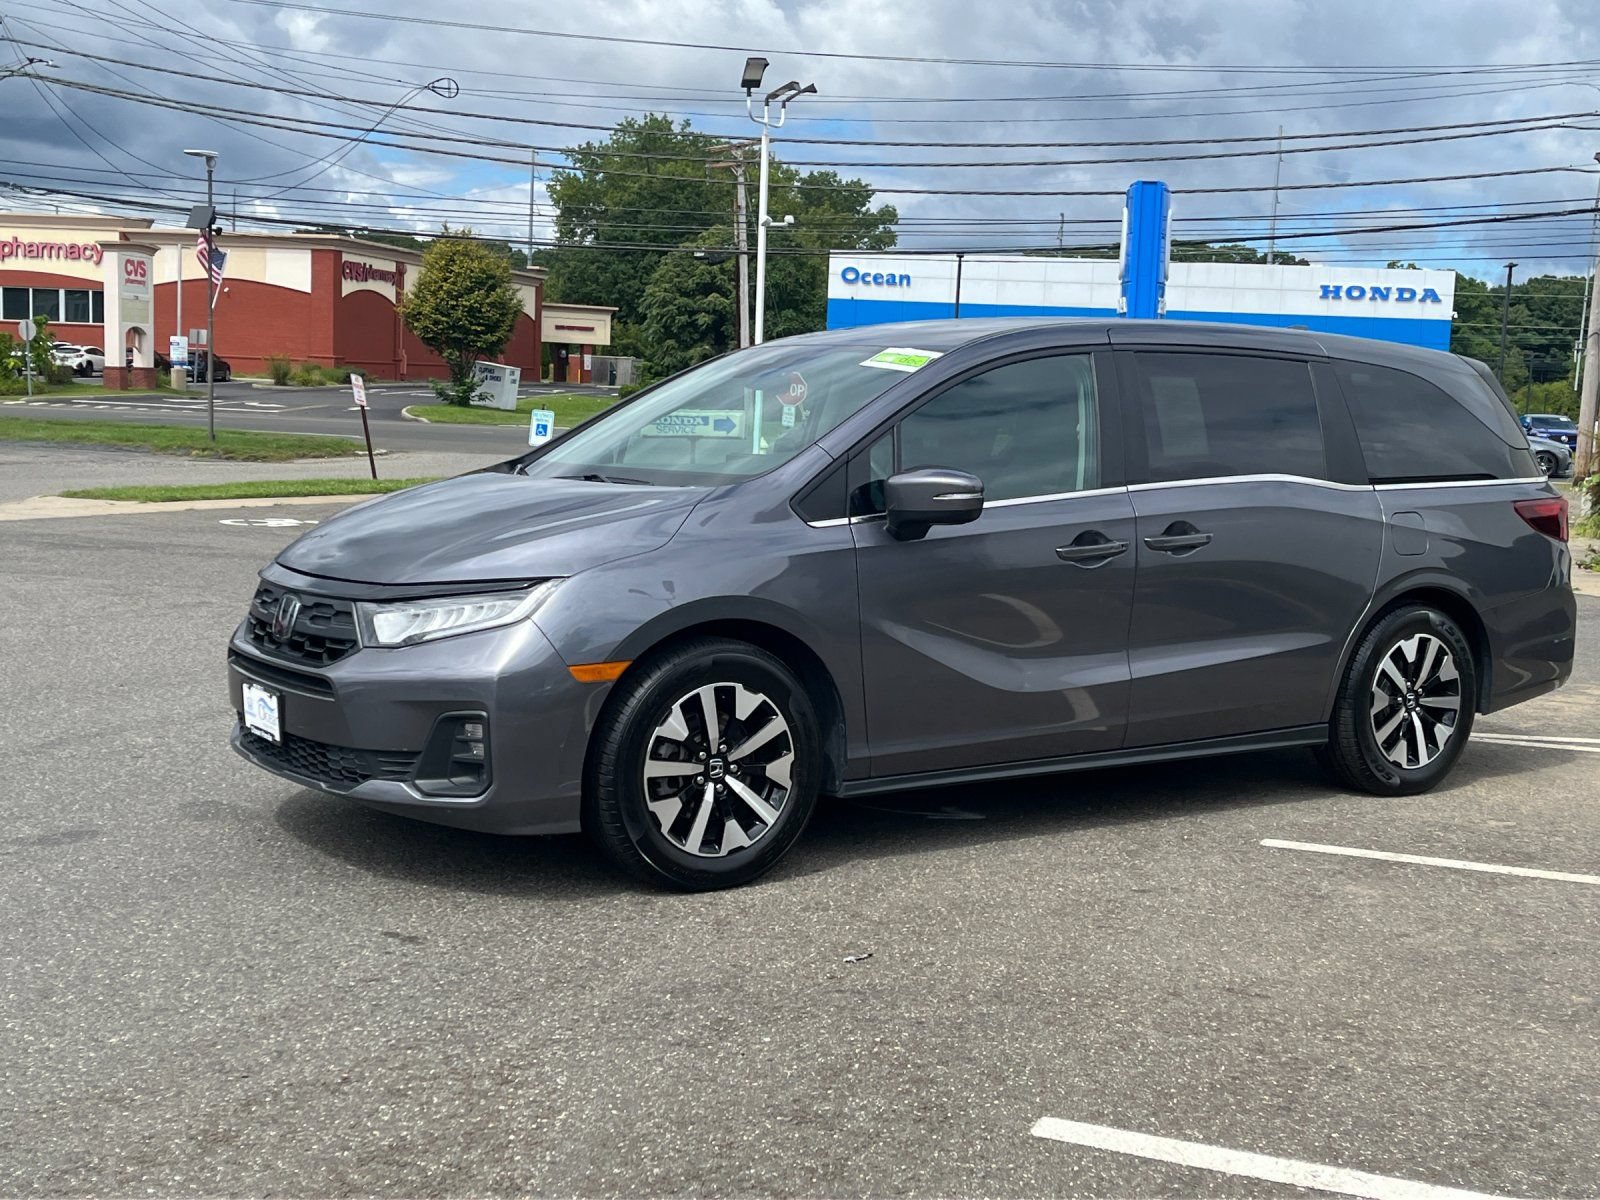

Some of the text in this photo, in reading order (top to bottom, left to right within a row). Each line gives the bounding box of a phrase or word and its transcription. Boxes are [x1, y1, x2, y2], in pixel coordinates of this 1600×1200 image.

[0, 236, 104, 265] pharmacy
[124, 258, 147, 278] CVS
[841, 266, 911, 287] Ocean
[1319, 284, 1443, 303] HONDA
[655, 424, 697, 434] SERVICE
